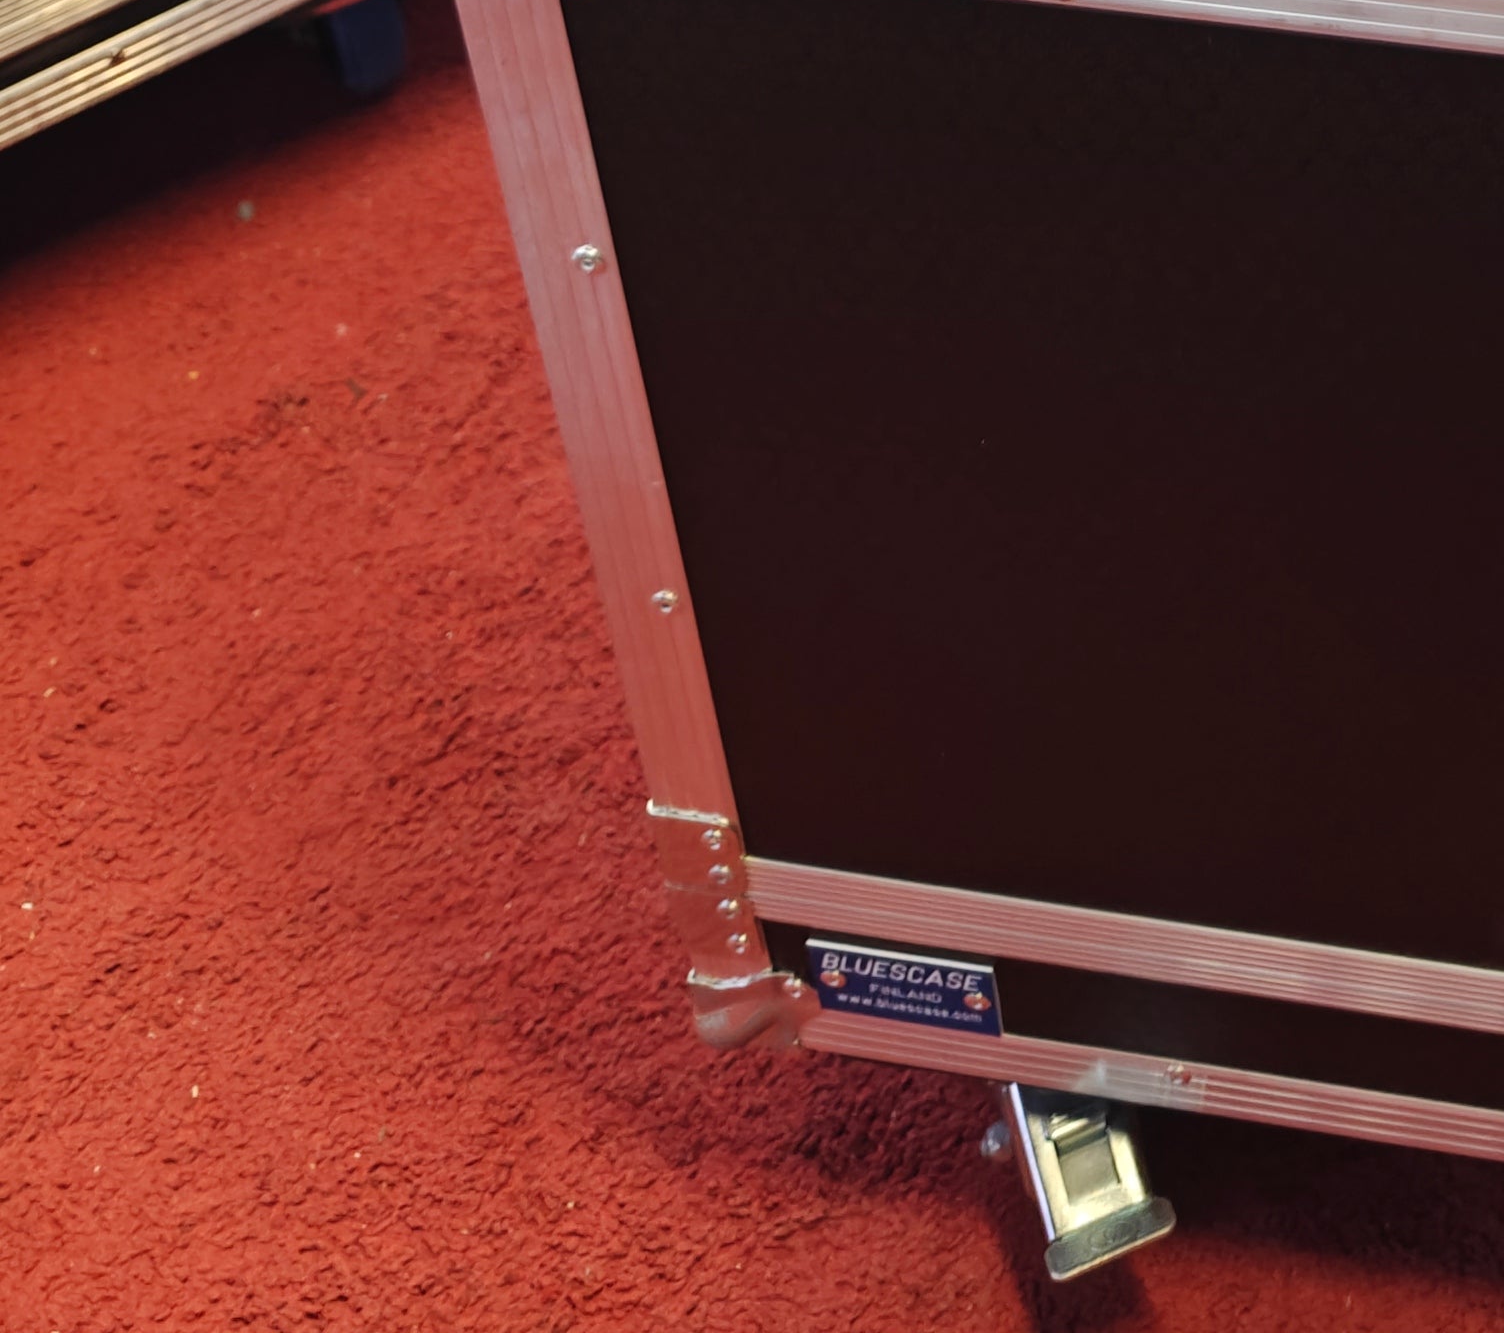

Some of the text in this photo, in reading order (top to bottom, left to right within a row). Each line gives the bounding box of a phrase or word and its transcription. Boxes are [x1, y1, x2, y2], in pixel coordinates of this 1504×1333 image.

[820, 952, 982, 992] BLUESCASE
[836, 993, 982, 1023] www.bluescase.com
[869, 983, 942, 1003] FINLAND
